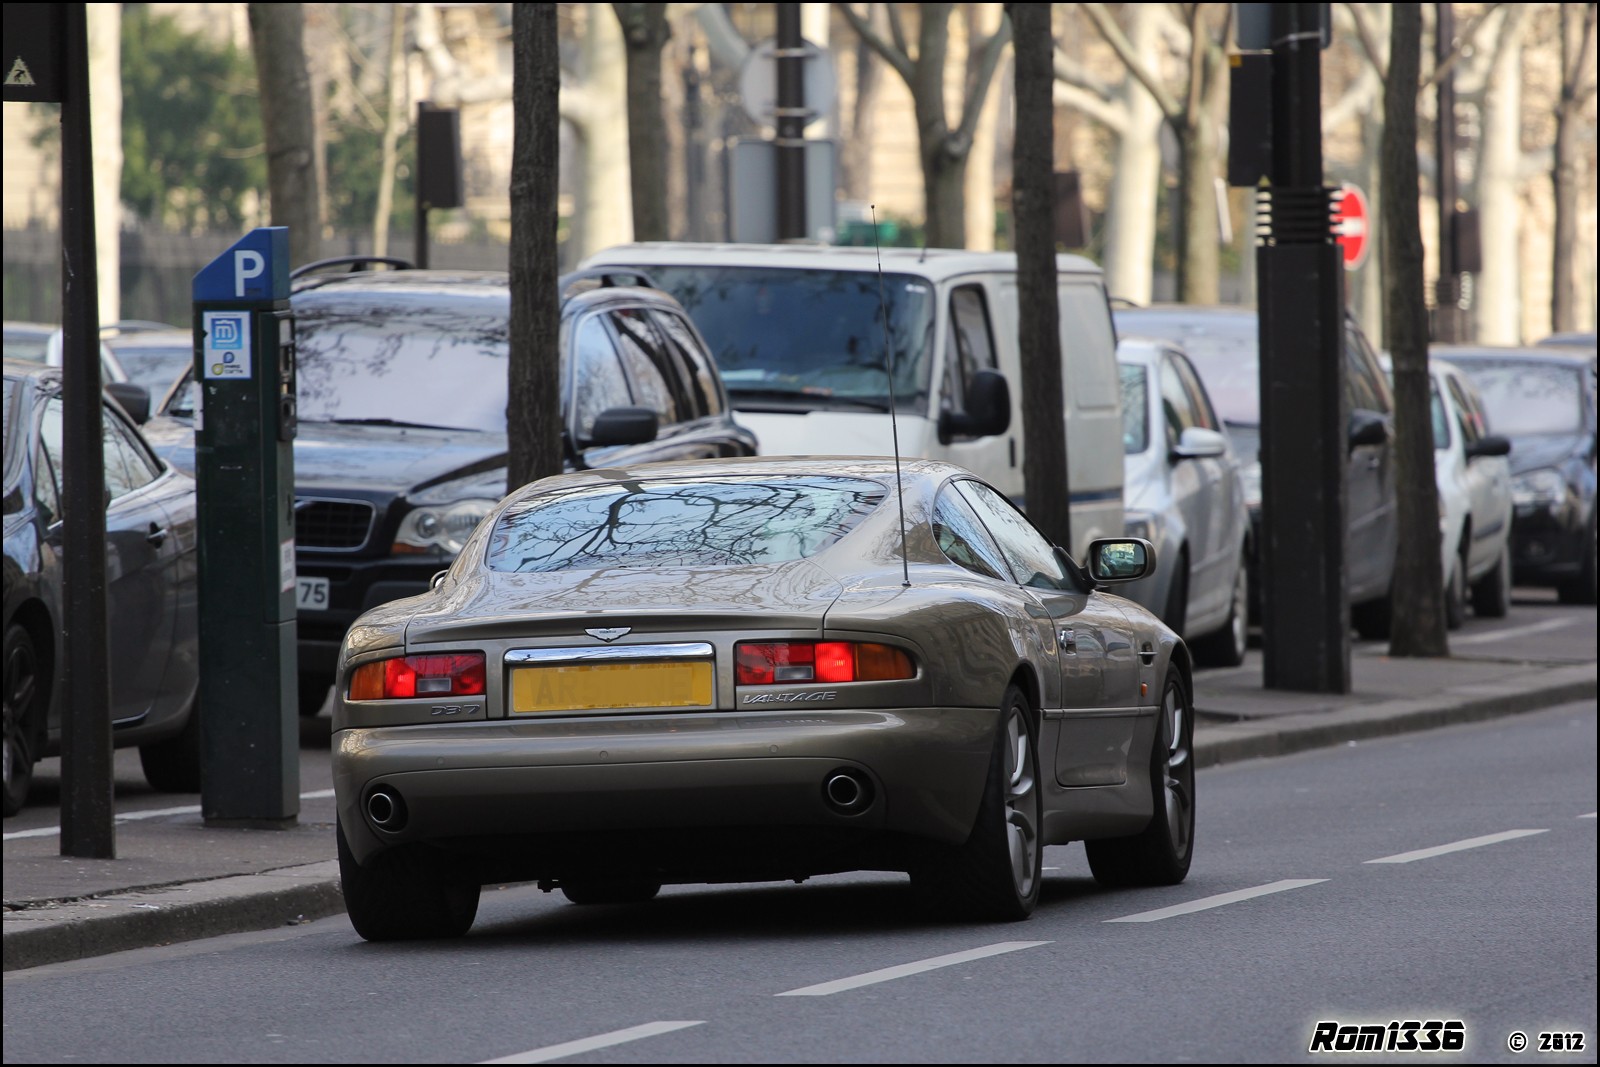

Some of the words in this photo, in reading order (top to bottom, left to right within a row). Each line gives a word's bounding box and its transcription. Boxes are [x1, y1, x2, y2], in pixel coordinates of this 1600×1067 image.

[235, 250, 265, 297] P
[300, 582, 326, 604] 75
[742, 691, 838, 705] VANTAGE
[431, 704, 480, 716] DB7
